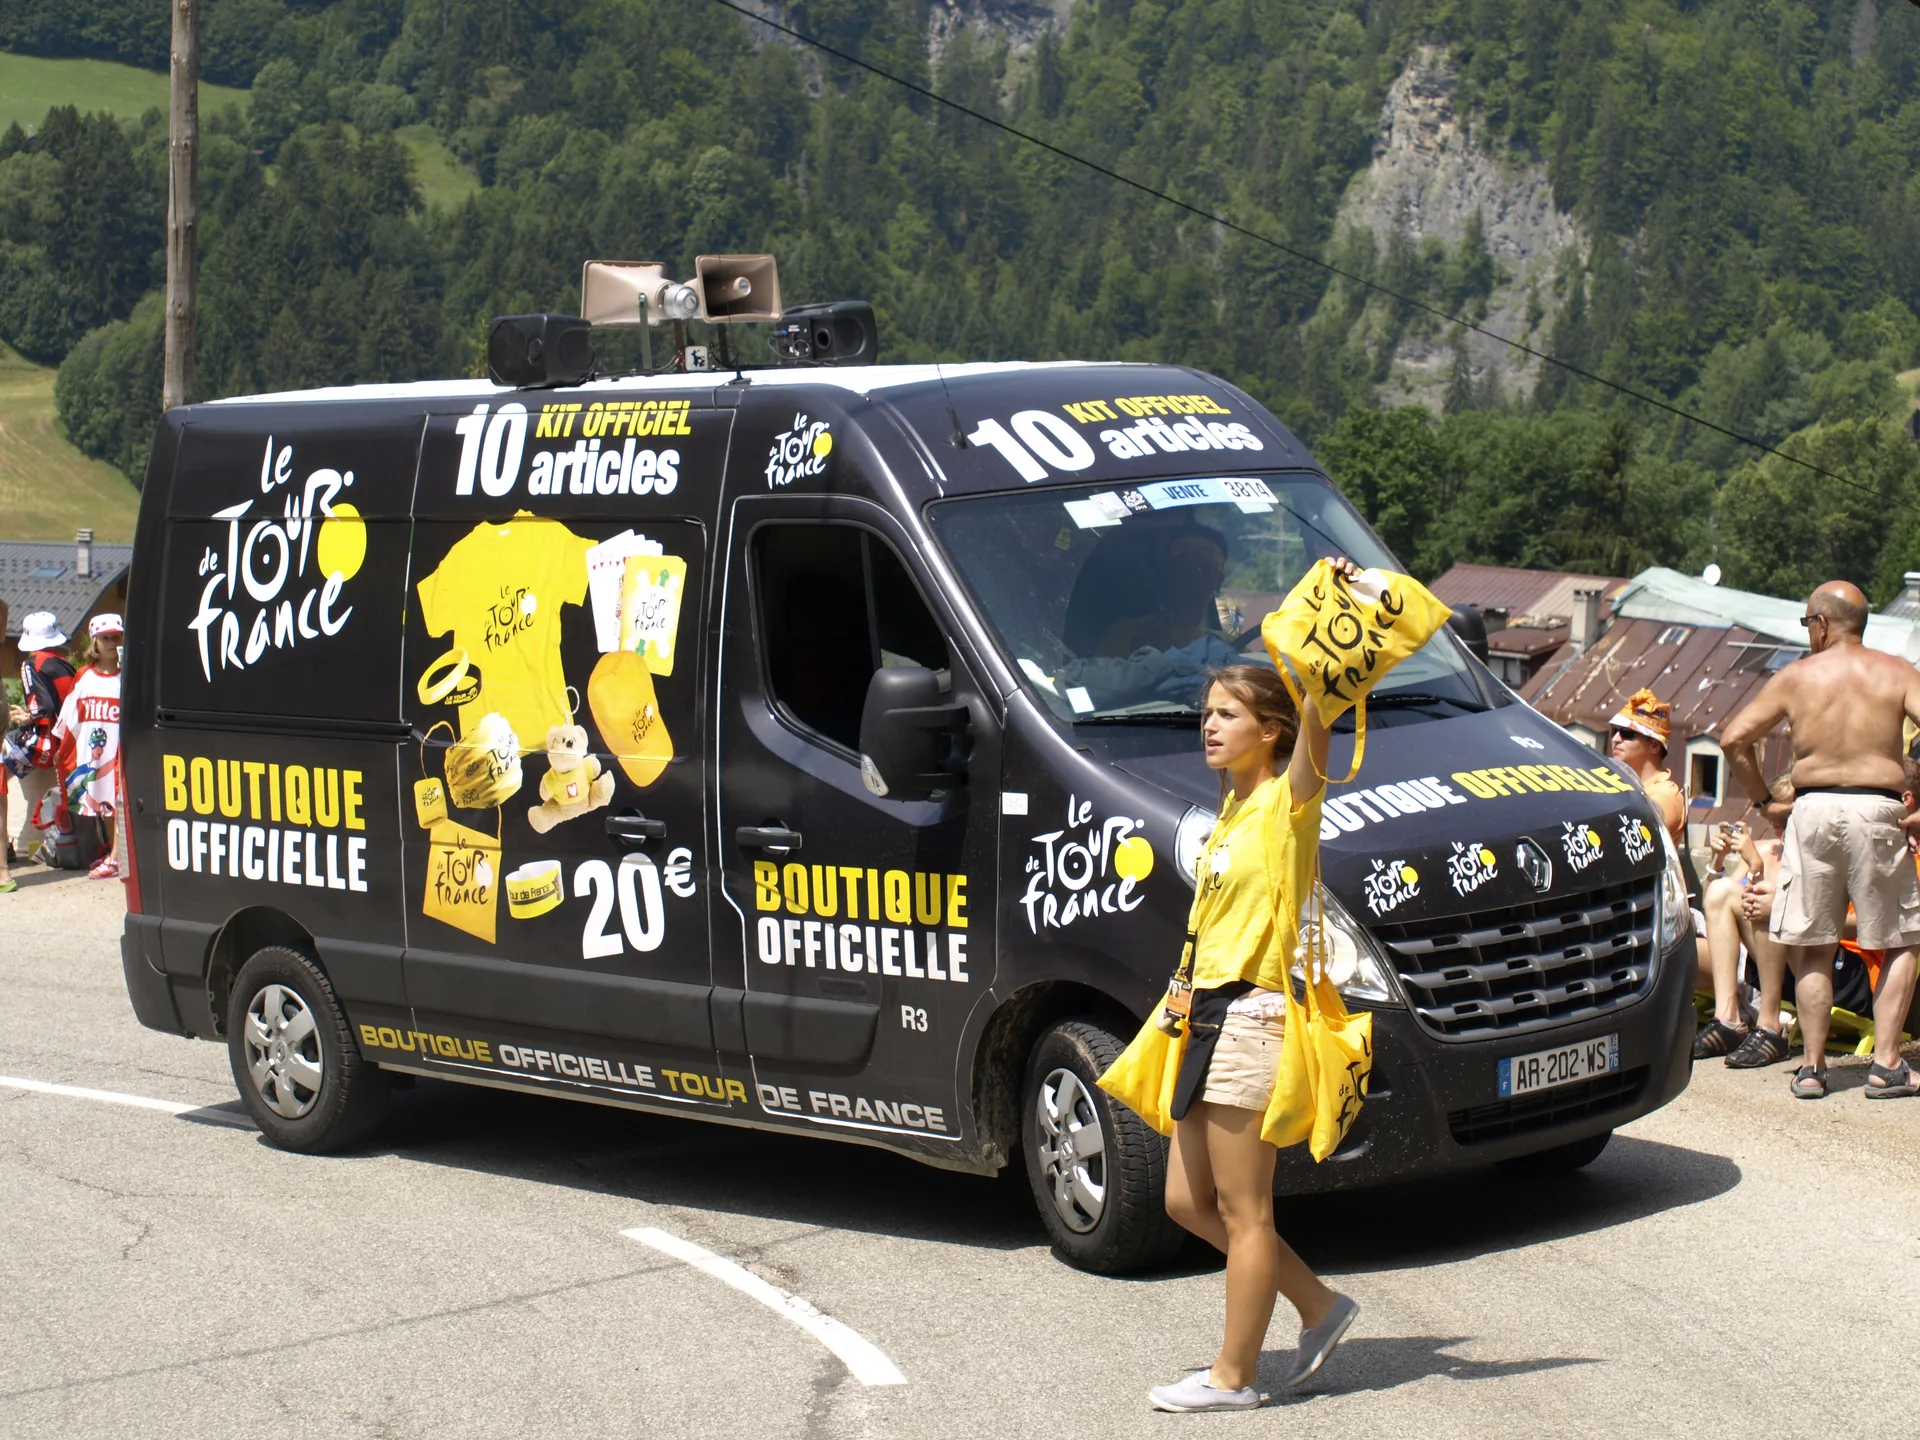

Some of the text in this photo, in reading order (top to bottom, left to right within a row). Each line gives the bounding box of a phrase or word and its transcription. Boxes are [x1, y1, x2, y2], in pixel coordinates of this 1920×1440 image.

[536, 400, 692, 438] KIT OFFICIEL
[1063, 395, 1232, 424] KIT OFFICIEL
[1099, 415, 1264, 460] articles
[454, 402, 528, 497] 10
[528, 438, 681, 496] articles
[967, 410, 1096, 483] 10
[1162, 481, 1270, 500] VENTE 3814
[82, 699, 120, 721] Vitte
[163, 754, 366, 830] BOUTIQUE
[1319, 764, 1635, 840] OUTIQUE OFFICIELLE
[167, 818, 367, 892] OFFICIELLE
[754, 860, 969, 928] BOUTIQUE
[757, 916, 969, 983] OFFICIELLE
[901, 1004, 928, 1032] R3
[359, 1024, 947, 1132] BOUTIQUE OFFICIELLE TOUR DE FRANCE
[1502, 1081, 1507, 1091] F
[1609, 1052, 1618, 1068] 76
